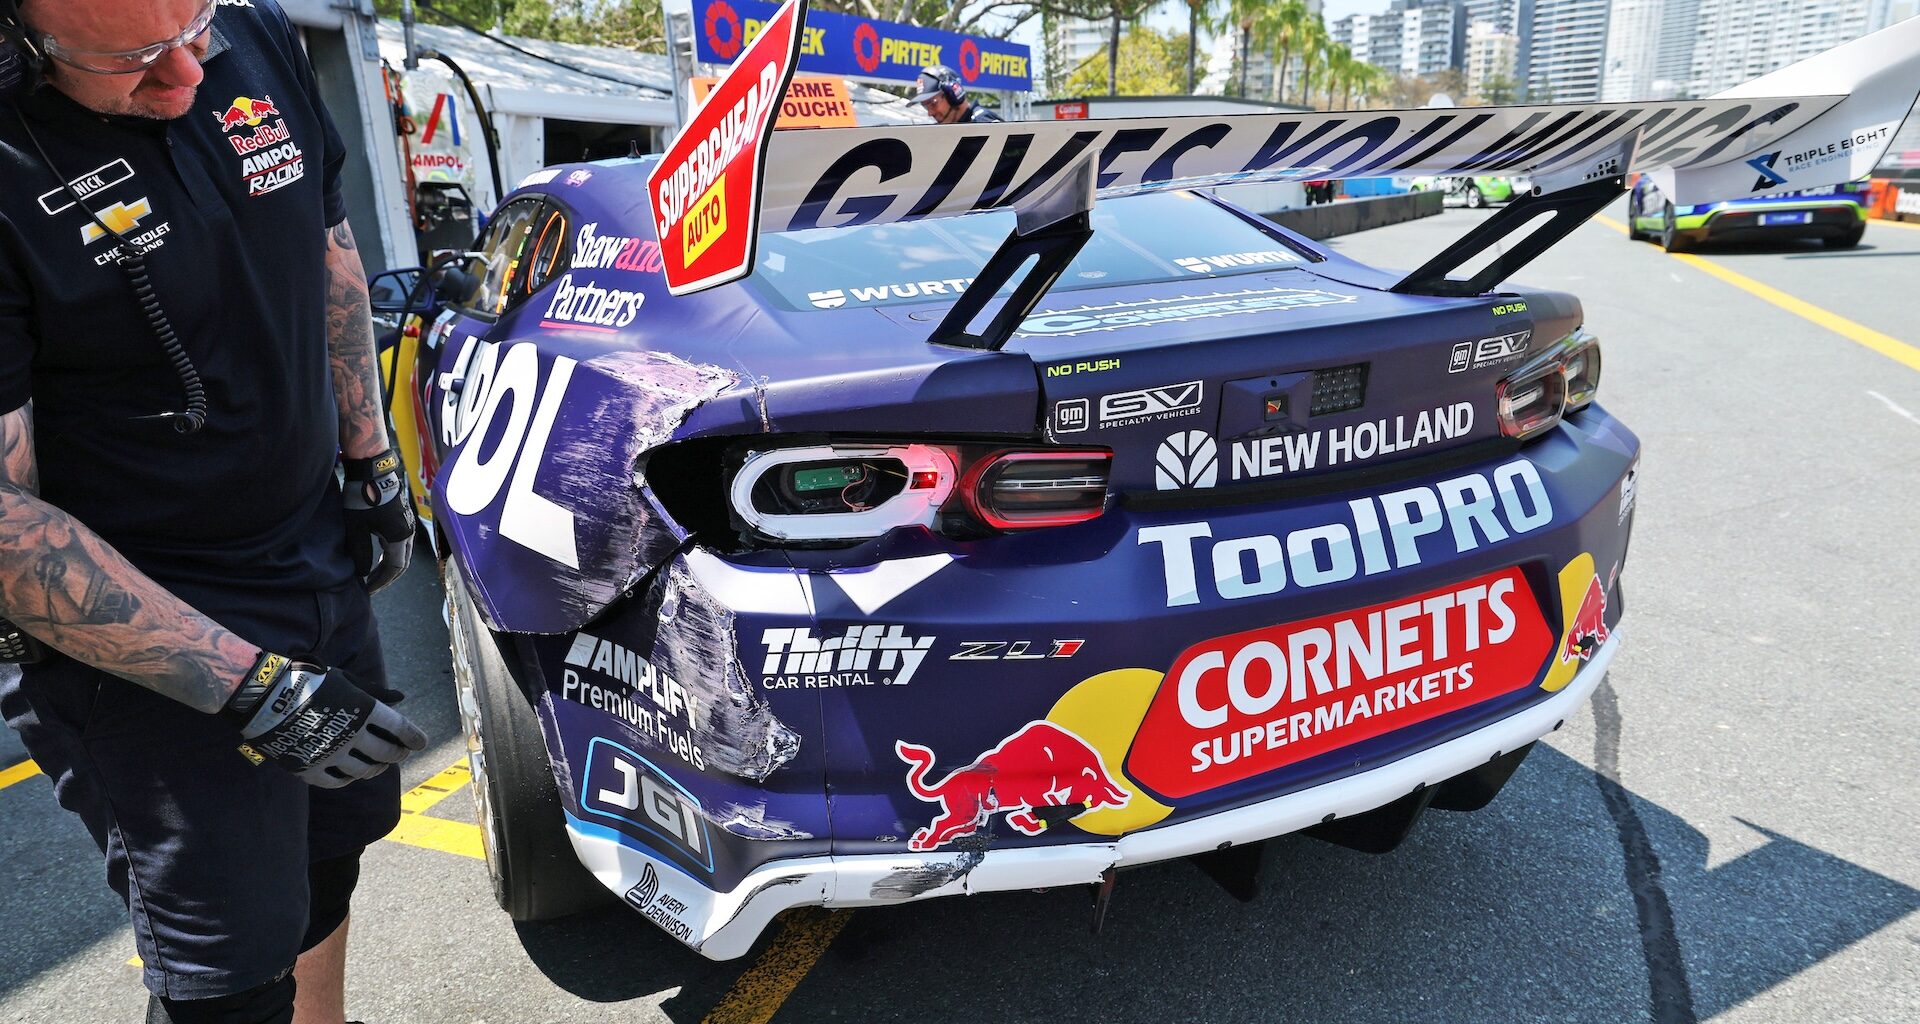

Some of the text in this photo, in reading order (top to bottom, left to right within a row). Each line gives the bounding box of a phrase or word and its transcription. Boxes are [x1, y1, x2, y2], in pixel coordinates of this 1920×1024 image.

[881, 37, 943, 68] PIRTEK
[980, 58, 1029, 79] PIRTEK
[779, 101, 848, 117] OUCH!
[228, 118, 290, 155] Red Bull
[659, 60, 778, 240] SUPERCHEAP
[1785, 127, 1888, 165] TRIPLE EIGHT
[242, 141, 302, 178] AMPOL
[249, 159, 304, 194] RACING
[413, 153, 464, 169] AMPOL
[1788, 162, 1813, 173] RACE
[72, 174, 106, 197] NICK
[687, 194, 721, 253] AUTO
[94, 221, 171, 266] CHEROLET
[544, 274, 646, 328] Partners
[1492, 303, 1527, 316] NO PUSH
[1047, 359, 1121, 378] NO PUSH
[1059, 405, 1084, 424] gm
[1099, 407, 1202, 430] SPECIALTY VEHICLES
[1102, 382, 1202, 419] SV
[1231, 401, 1474, 481] NEW HOLLAND
[1137, 458, 1554, 608] ToolPRO
[760, 625, 937, 685] Thrifty
[948, 639, 1086, 661] ZL1
[1177, 578, 1518, 730] CORNETTS
[590, 638, 700, 732] AMPLIFY
[762, 673, 874, 690] CAR RENTAL
[562, 670, 706, 772] Premium Fuels
[1191, 662, 1475, 774] SUPERMARKETS
[598, 757, 702, 854] JGI
[656, 892, 689, 915] AVERY
[645, 904, 693, 942] DENNISON
